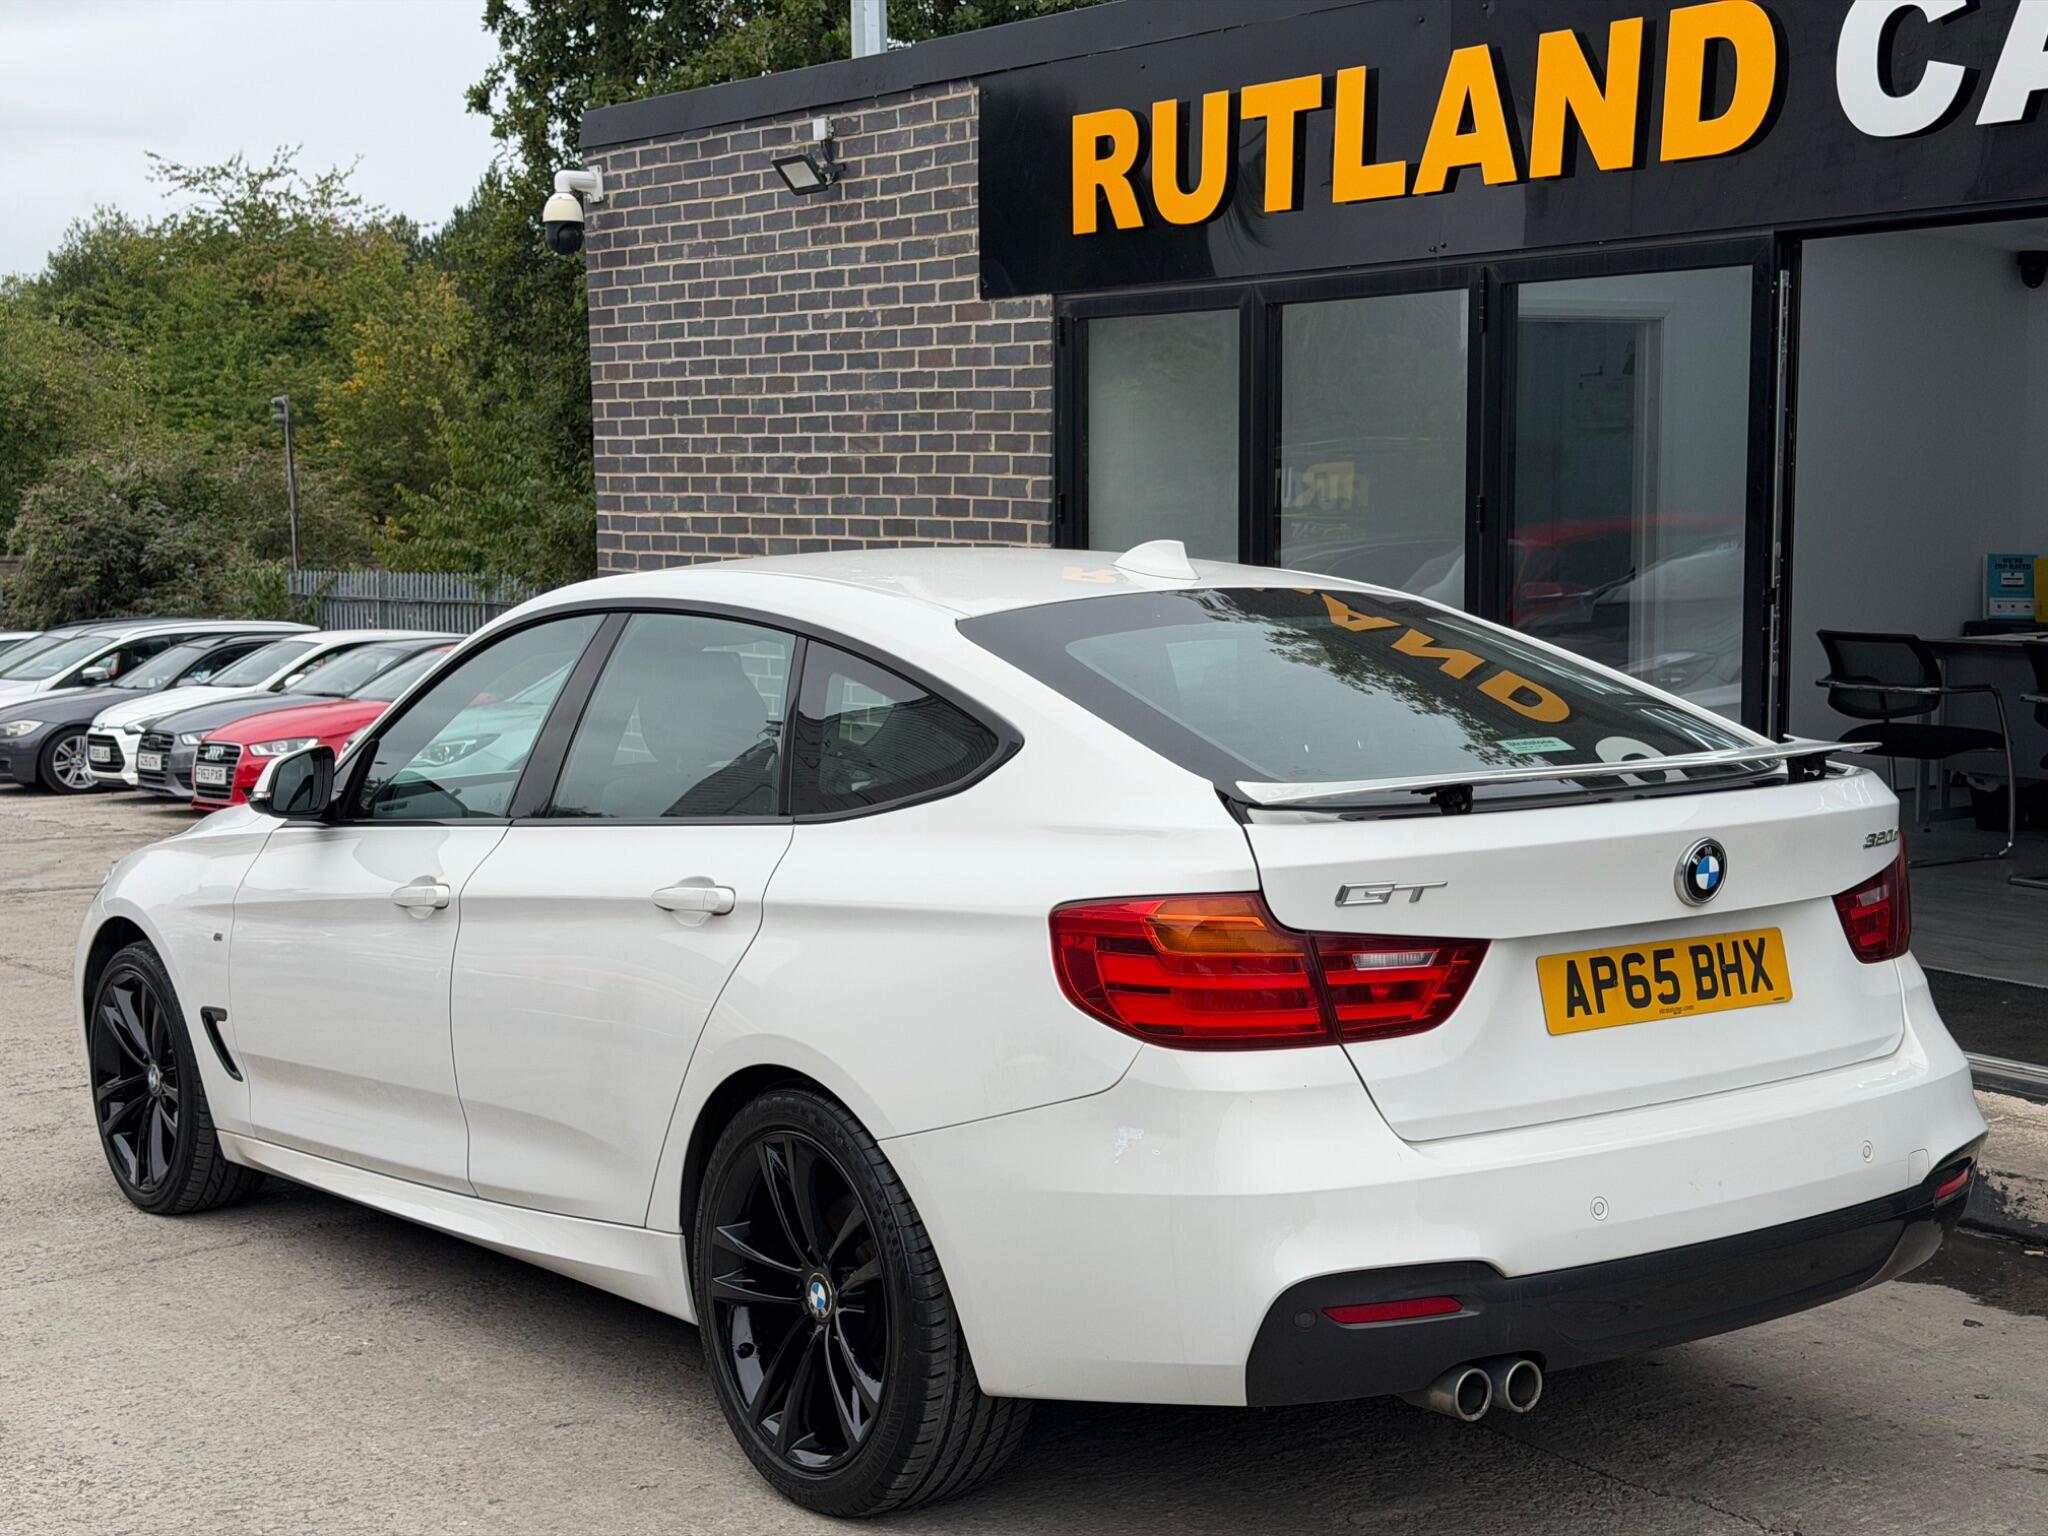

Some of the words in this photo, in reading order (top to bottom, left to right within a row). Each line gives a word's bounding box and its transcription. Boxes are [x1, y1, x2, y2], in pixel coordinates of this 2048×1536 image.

[1072, 0, 1778, 236] RUTLAND
[1335, 881, 1448, 907] GT
[1566, 948, 1681, 1018] AP65
[1688, 937, 1774, 1001] BHX
